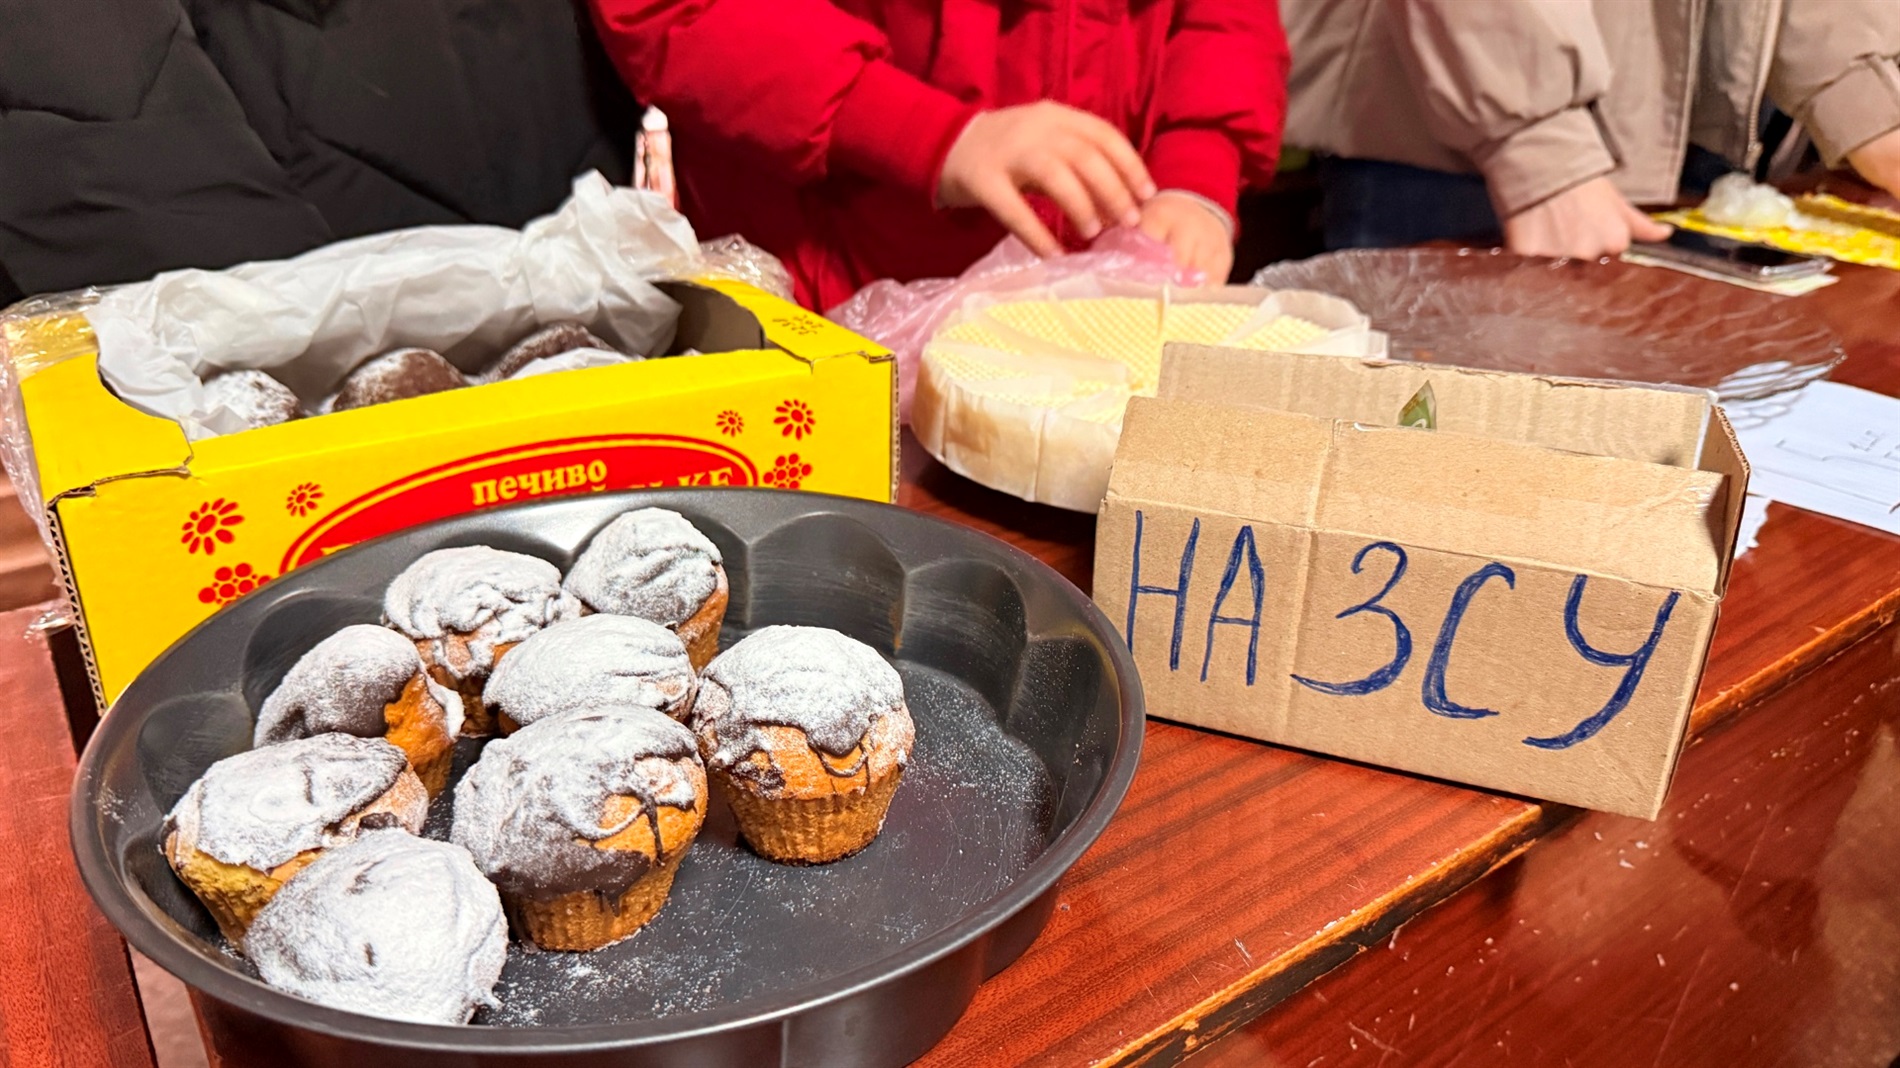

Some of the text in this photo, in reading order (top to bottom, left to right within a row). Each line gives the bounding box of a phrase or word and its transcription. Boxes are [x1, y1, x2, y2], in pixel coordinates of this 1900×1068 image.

[470, 459, 608, 506] печиво
[1126, 509, 1682, 750] НА ЗСУ
